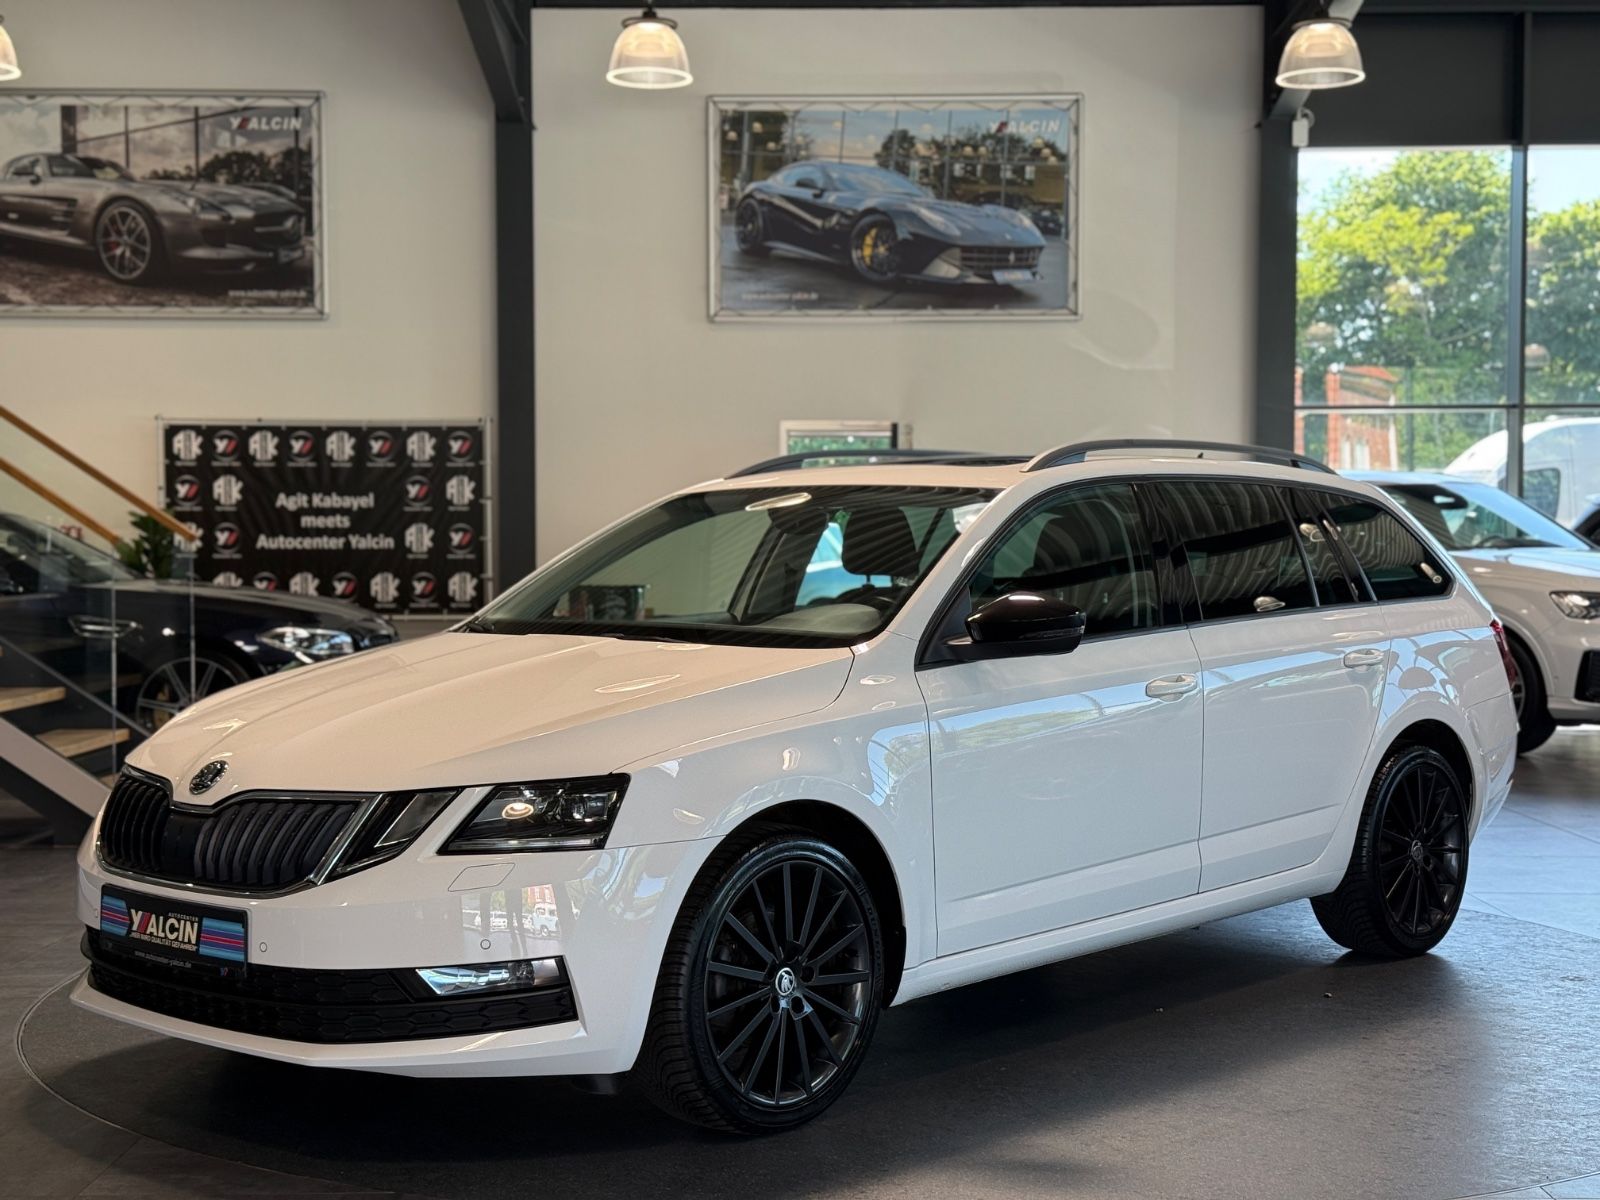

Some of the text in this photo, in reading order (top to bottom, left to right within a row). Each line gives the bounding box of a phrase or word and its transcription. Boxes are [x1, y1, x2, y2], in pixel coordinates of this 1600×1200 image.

[275, 492, 375, 511] Agit Kabayel
[300, 514, 351, 529] meets
[256, 533, 395, 550] Autocenter Yalcin
[130, 908, 199, 945] YALCIN
